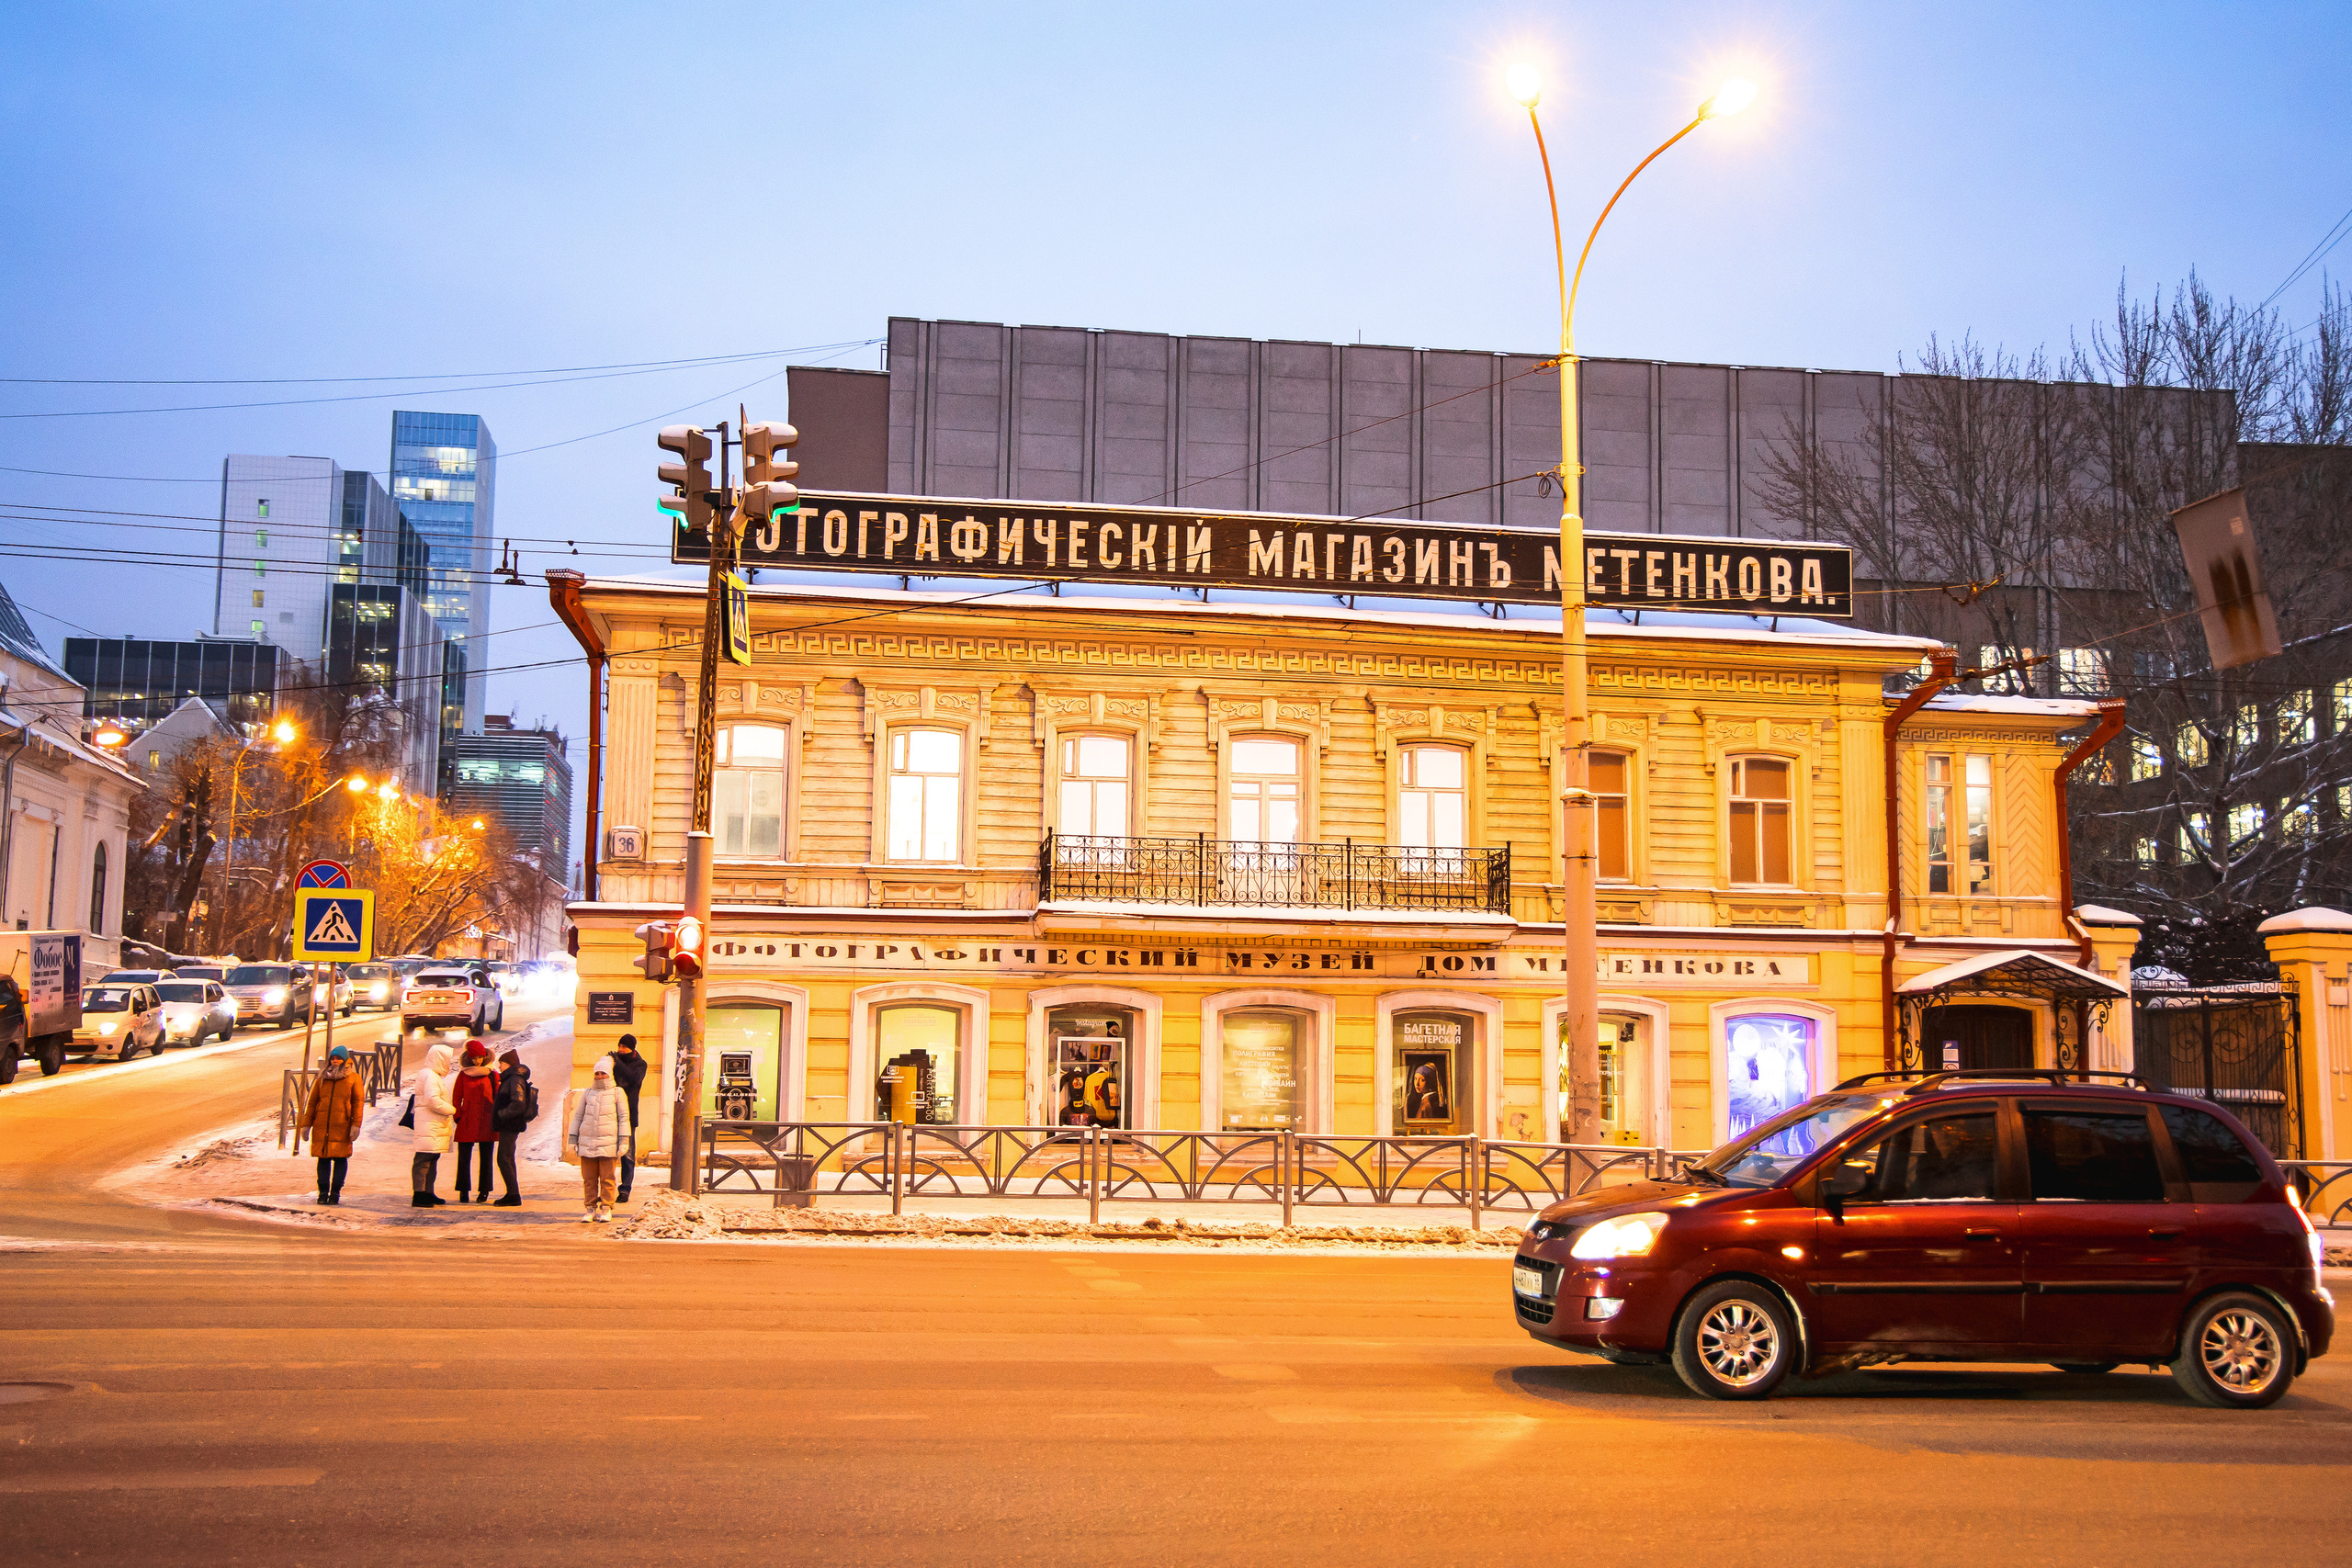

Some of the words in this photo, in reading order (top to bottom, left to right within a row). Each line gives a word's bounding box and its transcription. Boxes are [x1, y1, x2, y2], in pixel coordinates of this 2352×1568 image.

[707, 508, 1210, 574] ОТОГРАФИЧЕСКІЙ
[1250, 529, 1511, 589] МАГАЗИНЪ
[618, 837, 634, 852] 36
[712, 942, 1198, 967] ФОТОГРАФИЧЕСКИЙ
[1226, 950, 1374, 970] МУЗЕЙ
[1416, 955, 1497, 978] ДОМ
[1525, 957, 1782, 976] МЕНКОВА
[1404, 1023, 1461, 1035] БАГЕТНАЯ
[1404, 1035, 1461, 1044] МАСТЕРСКАЯ
